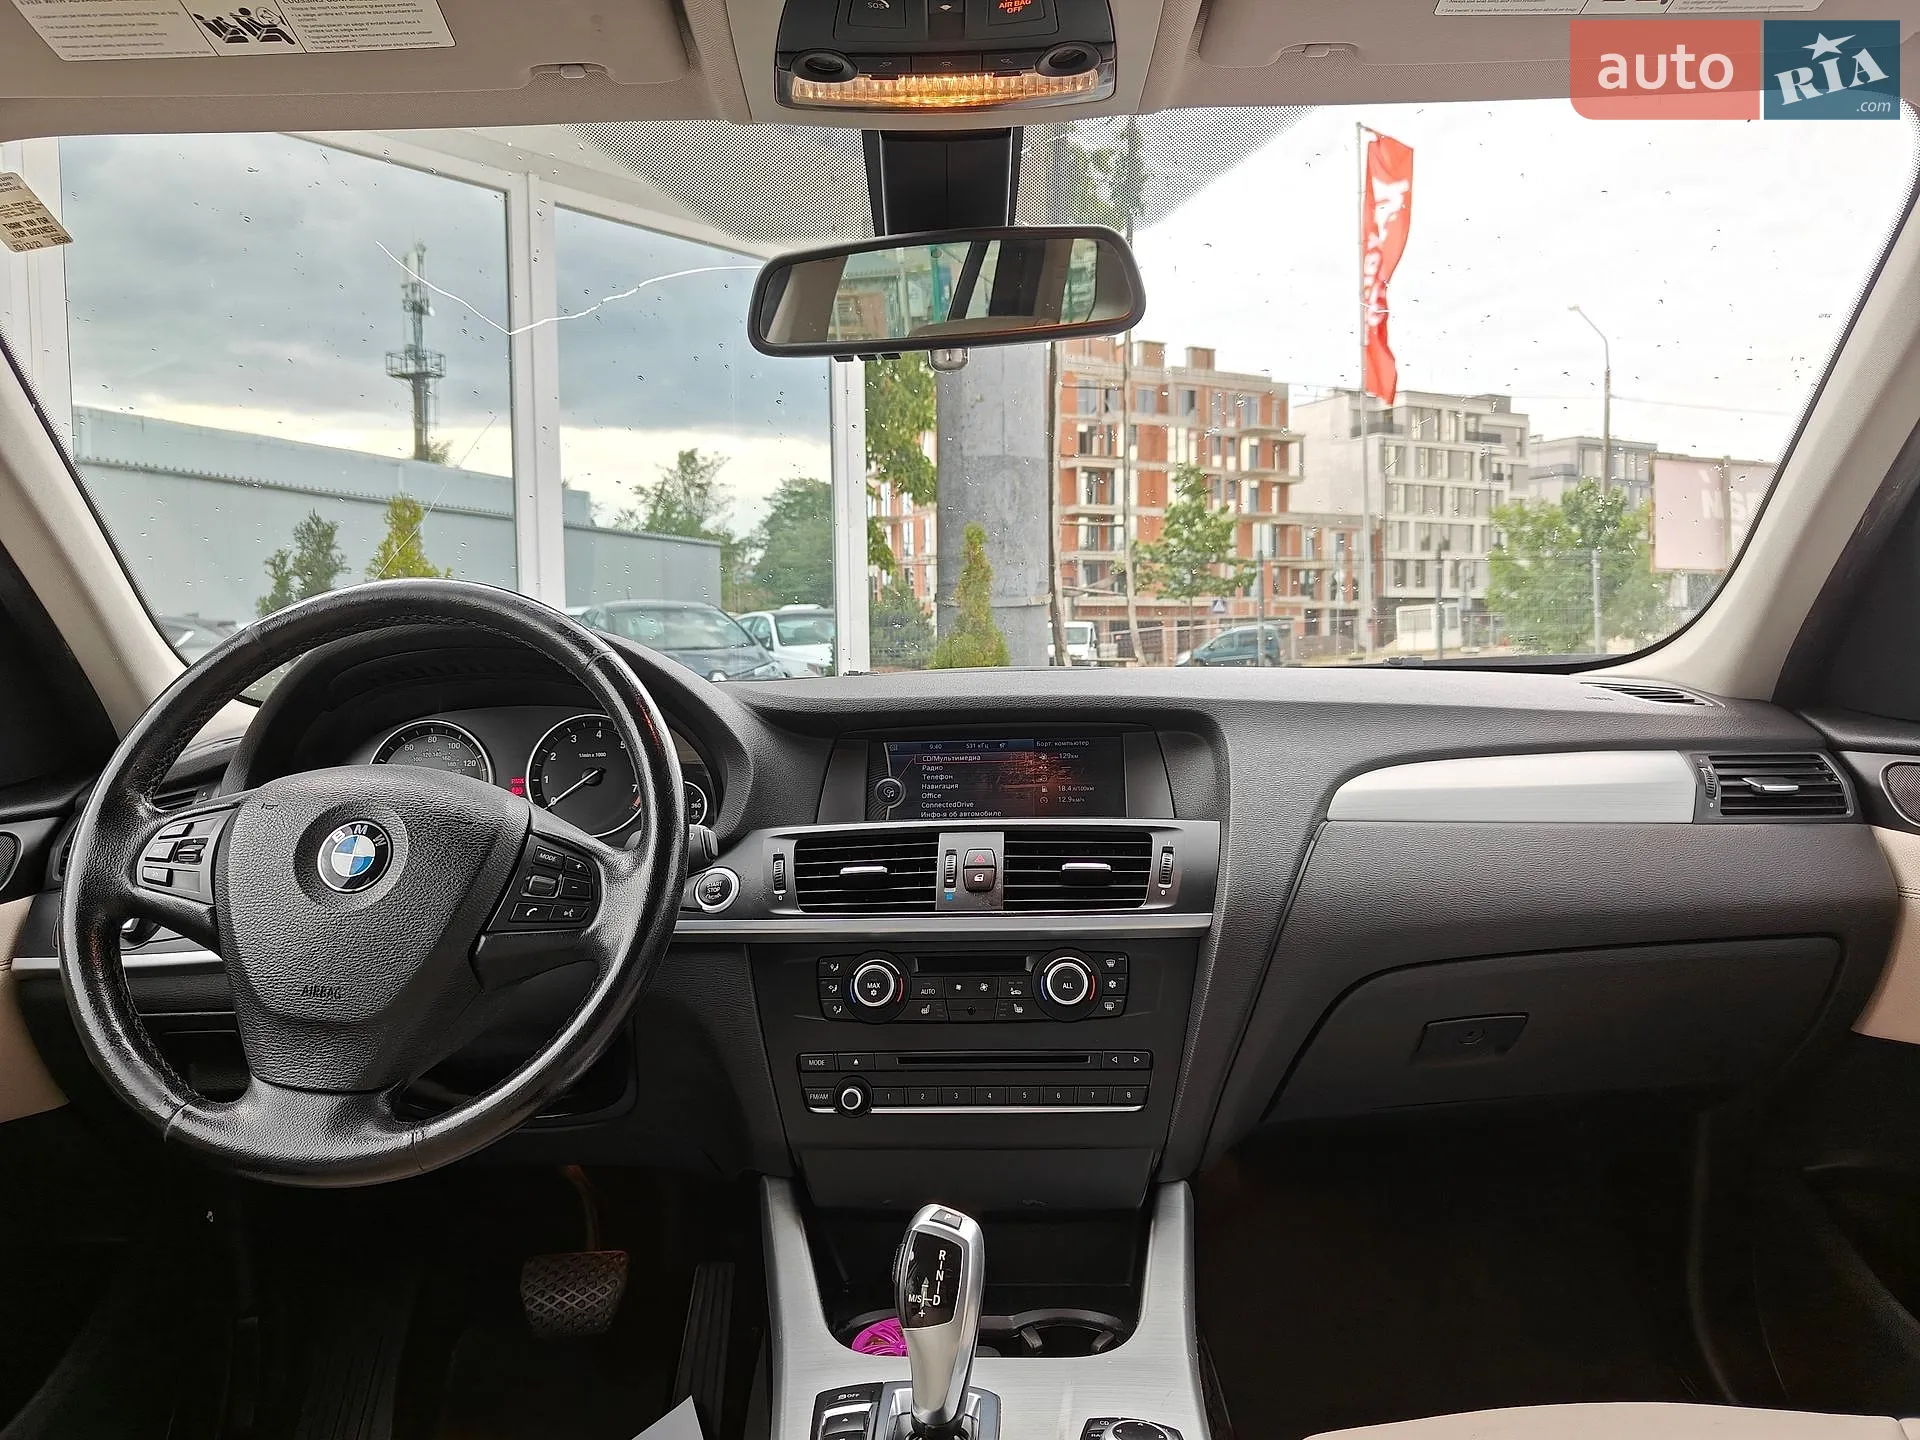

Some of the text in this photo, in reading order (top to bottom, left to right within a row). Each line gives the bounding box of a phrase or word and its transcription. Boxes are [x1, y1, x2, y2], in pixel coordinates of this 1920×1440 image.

[1006, 6, 1023, 14] OFF
[10, 230, 28, 239] YOUR
[570, 734, 577, 743] 3
[595, 730, 602, 739] 4
[620, 741, 627, 750] 5
[550, 752, 557, 761] 2
[463, 759, 477, 767] 120
[544, 776, 549, 784] 1
[632, 784, 638, 793] 7
[921, 783, 959, 791] Навигация
[921, 801, 974, 809] ConnectedDrive
[332, 824, 387, 847] BMW
[539, 852, 557, 862] MODE
[706, 880, 722, 888] START
[300, 985, 342, 999] AIRBAG
[939, 1250, 947, 1261] R
[936, 1269, 945, 1282] N
[908, 1293, 941, 1306] M/S D
